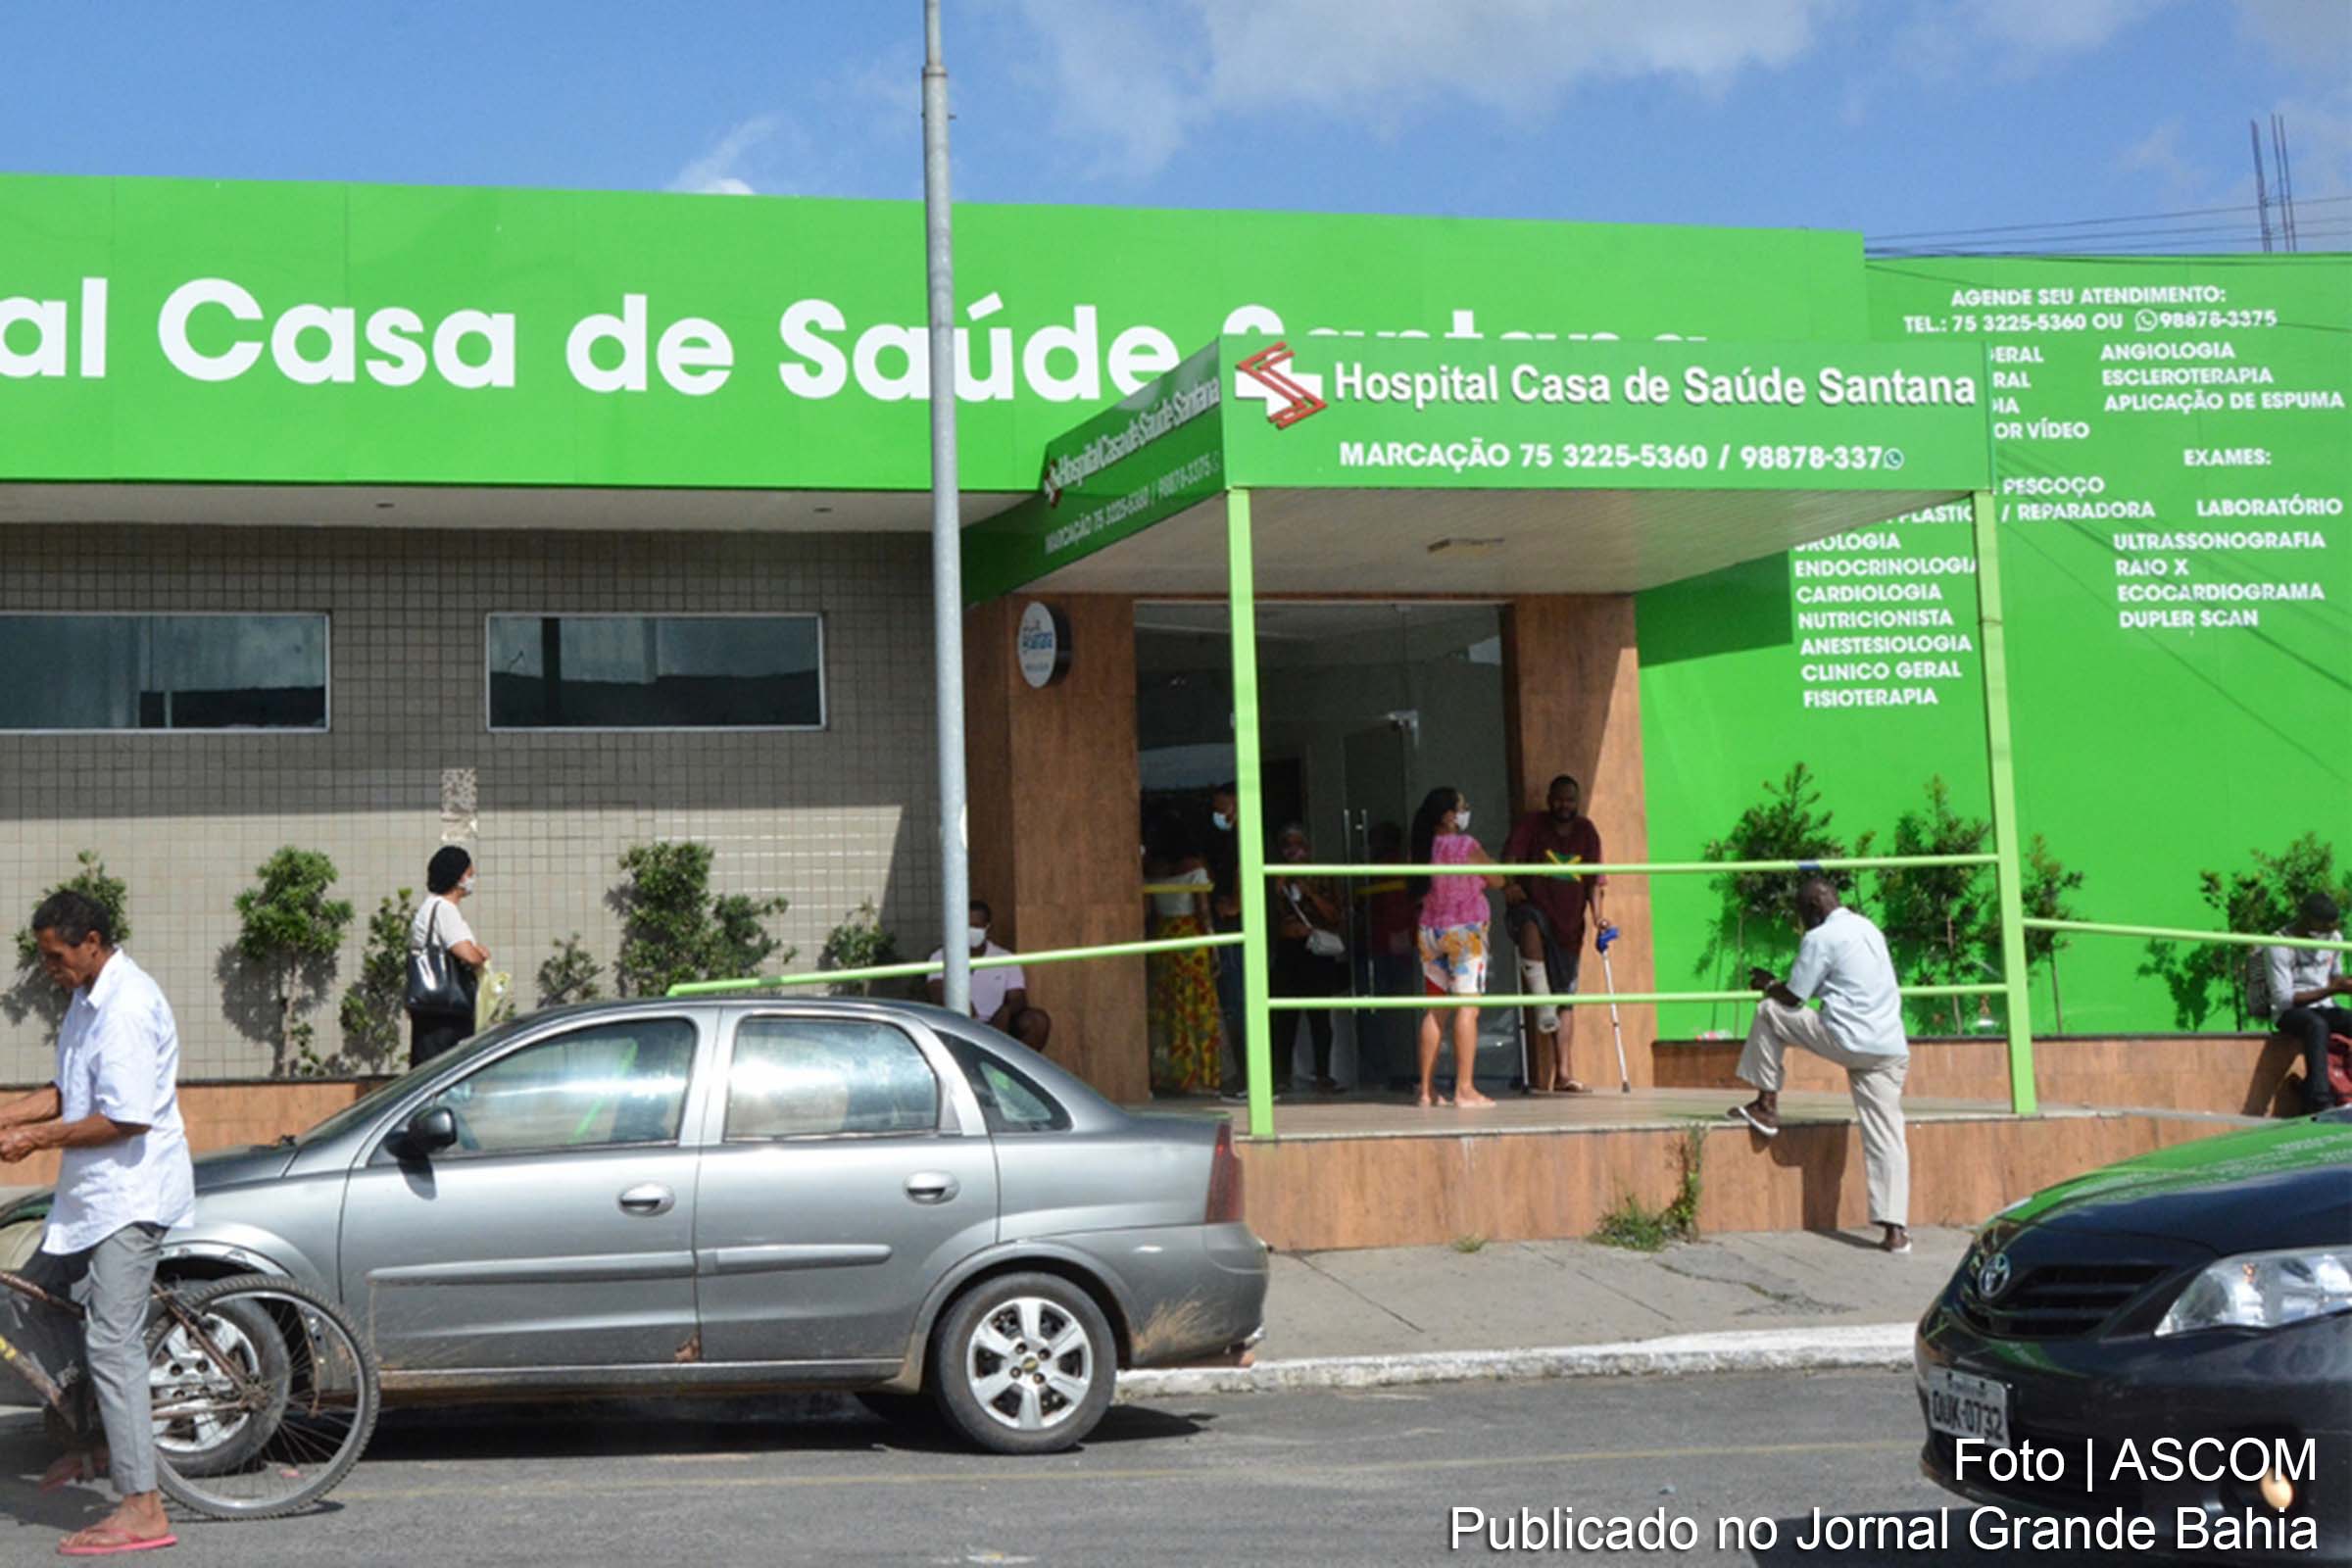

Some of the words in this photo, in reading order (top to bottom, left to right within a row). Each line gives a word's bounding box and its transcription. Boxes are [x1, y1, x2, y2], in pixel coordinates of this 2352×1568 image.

[1952, 289, 2032, 306] AGENDE
[2038, 288, 2074, 305] SEU
[2081, 285, 2226, 304] ATENDIMENTO:
[1904, 316, 1946, 332] TEL.:
[1953, 316, 1977, 332] 75
[1984, 314, 2086, 331] 3225-5360
[2092, 313, 2123, 329] OU
[2159, 310, 2277, 328] 98878-3375
[0, 278, 106, 376] al
[160, 279, 514, 387] Casa
[567, 295, 732, 394] de
[780, 293, 1180, 403] Saúde
[1990, 346, 2043, 363] ERAL
[2101, 342, 2235, 361] ANGIOLOGIA
[1337, 364, 1497, 408] Hospital
[1512, 365, 1610, 401] Casa
[1625, 368, 1669, 402] de
[1686, 368, 1805, 403] Saúde
[1820, 368, 1975, 403] Santana
[2103, 368, 2274, 386] ESCLEROTERAPIA
[2105, 389, 2224, 414] APLICAÇÃO
[2230, 392, 2256, 409] DE
[2262, 392, 2344, 409] ESPUMA
[2027, 417, 2089, 439] VÍDEO
[1341, 438, 1510, 471] MARCAÇÃO
[1521, 445, 1551, 466] 75
[1564, 445, 1707, 468] 3225-5360
[1720, 445, 1729, 468] /
[2184, 448, 2271, 466] EXAMES:
[2003, 476, 2105, 497] PESCOÇO
[2018, 502, 2155, 520] REPARADORA
[2197, 494, 2343, 516] LABORATÓRIO
[2114, 532, 2326, 550] ULTRASSONOGRAFIA
[2116, 559, 2168, 575] RAIO
[2175, 559, 2189, 575] X
[1796, 583, 1942, 604] CARDIOLOGIA
[2118, 583, 2325, 602] ECOCARDIOGRAMA
[1798, 609, 1953, 628] NUTRICIONISTA
[2120, 611, 2195, 627] DUPLER
[2200, 610, 2258, 627] SCAN
[1801, 635, 1972, 655] ANESTESIOLOGIA
[1801, 662, 1889, 681] CLINICO
[1895, 662, 1961, 679] GERAL
[1804, 688, 1938, 707] FISIOTERAPIA
